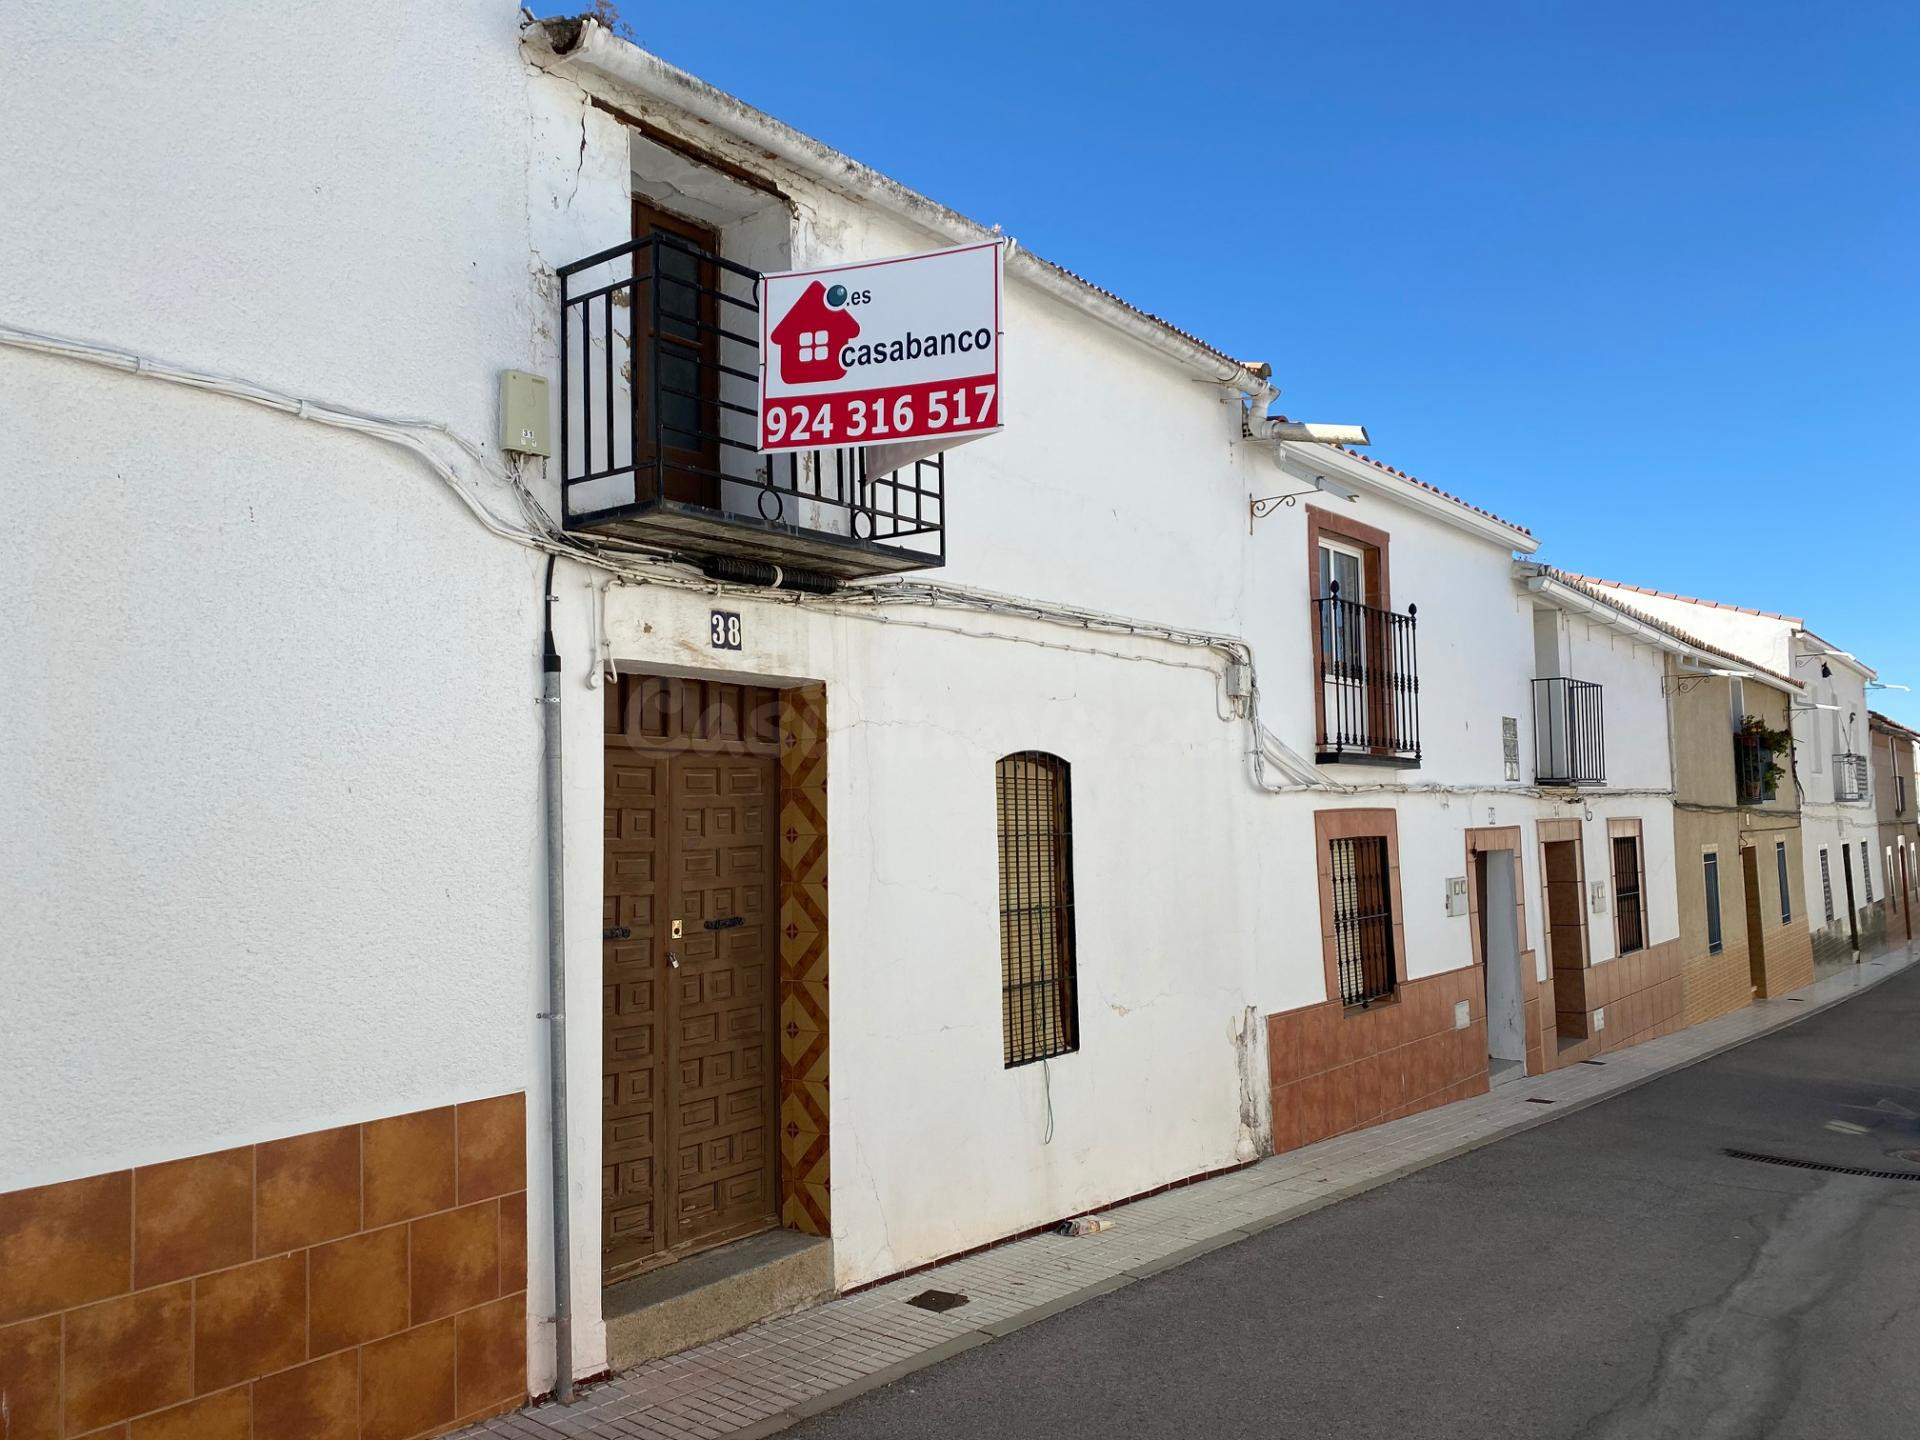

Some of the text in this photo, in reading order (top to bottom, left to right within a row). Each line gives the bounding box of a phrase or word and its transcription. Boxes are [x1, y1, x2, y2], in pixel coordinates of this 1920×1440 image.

[846, 289, 871, 306] .es
[841, 327, 991, 367] casabanco
[766, 384, 996, 443] 924 316 517
[712, 614, 741, 647] 38
